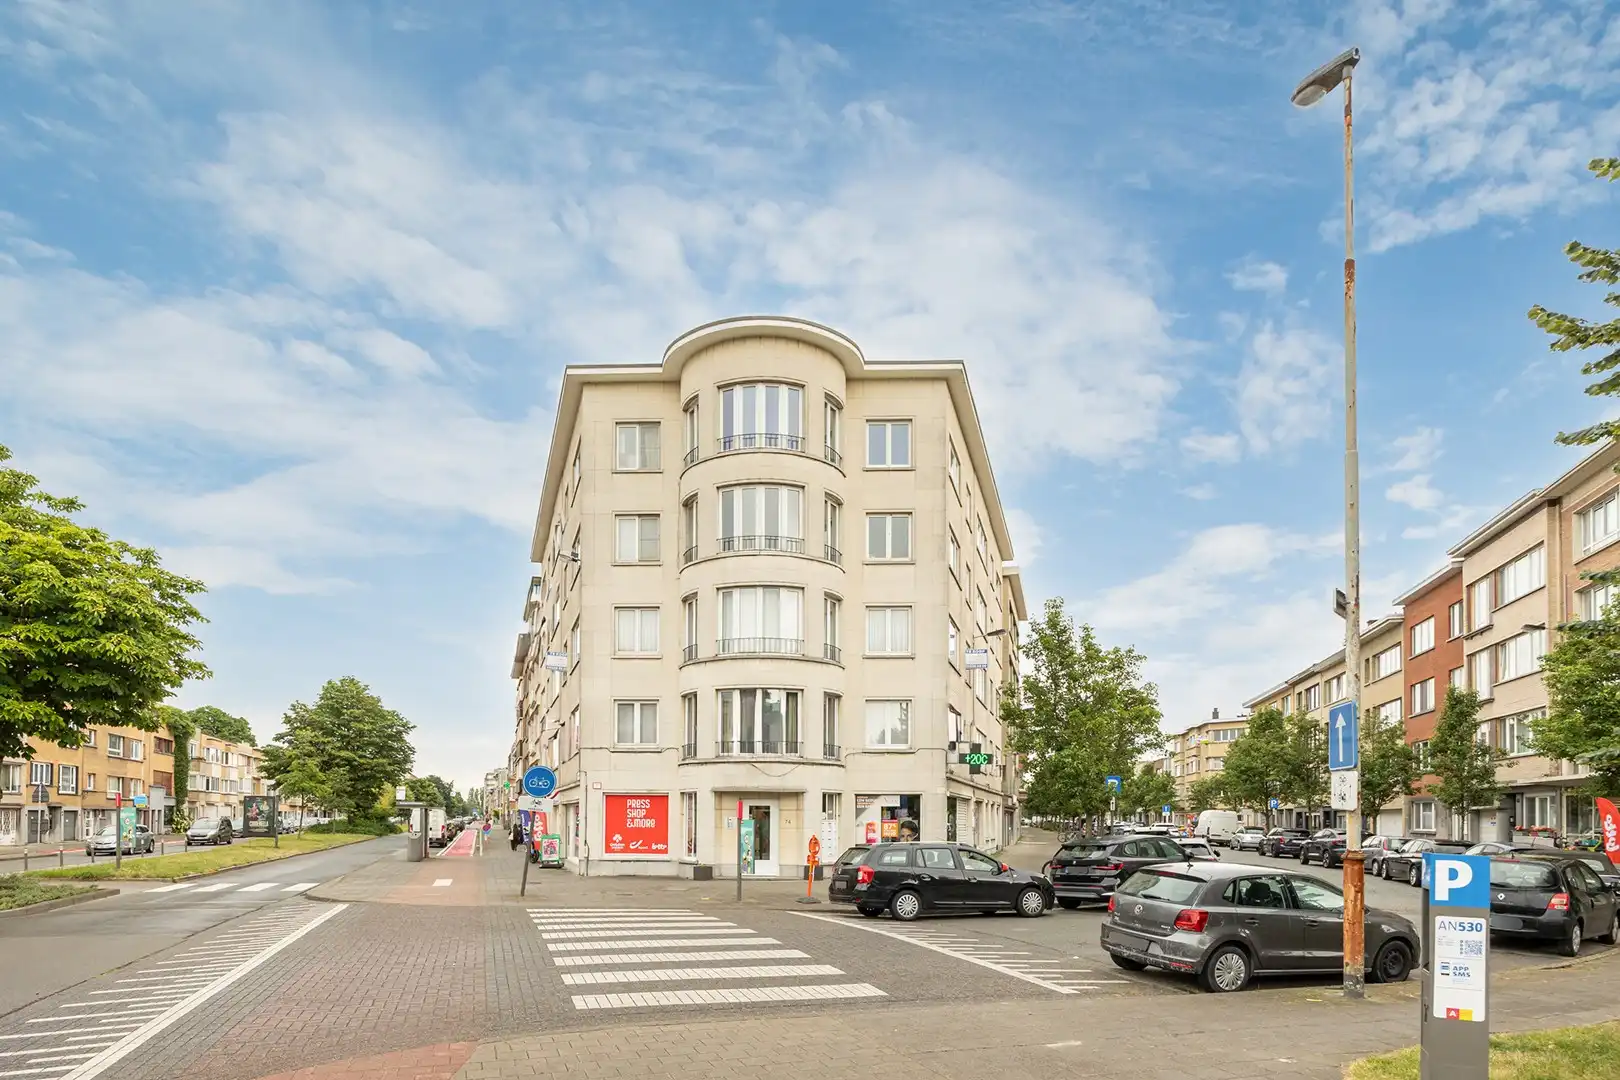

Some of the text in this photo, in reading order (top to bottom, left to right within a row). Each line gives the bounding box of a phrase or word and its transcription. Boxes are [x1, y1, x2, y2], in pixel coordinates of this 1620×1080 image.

[1271, 799, 1277, 808] P
[626, 809, 646, 818] SHOP
[1435, 859, 1473, 901] P
[1438, 920, 1483, 933] AN530
